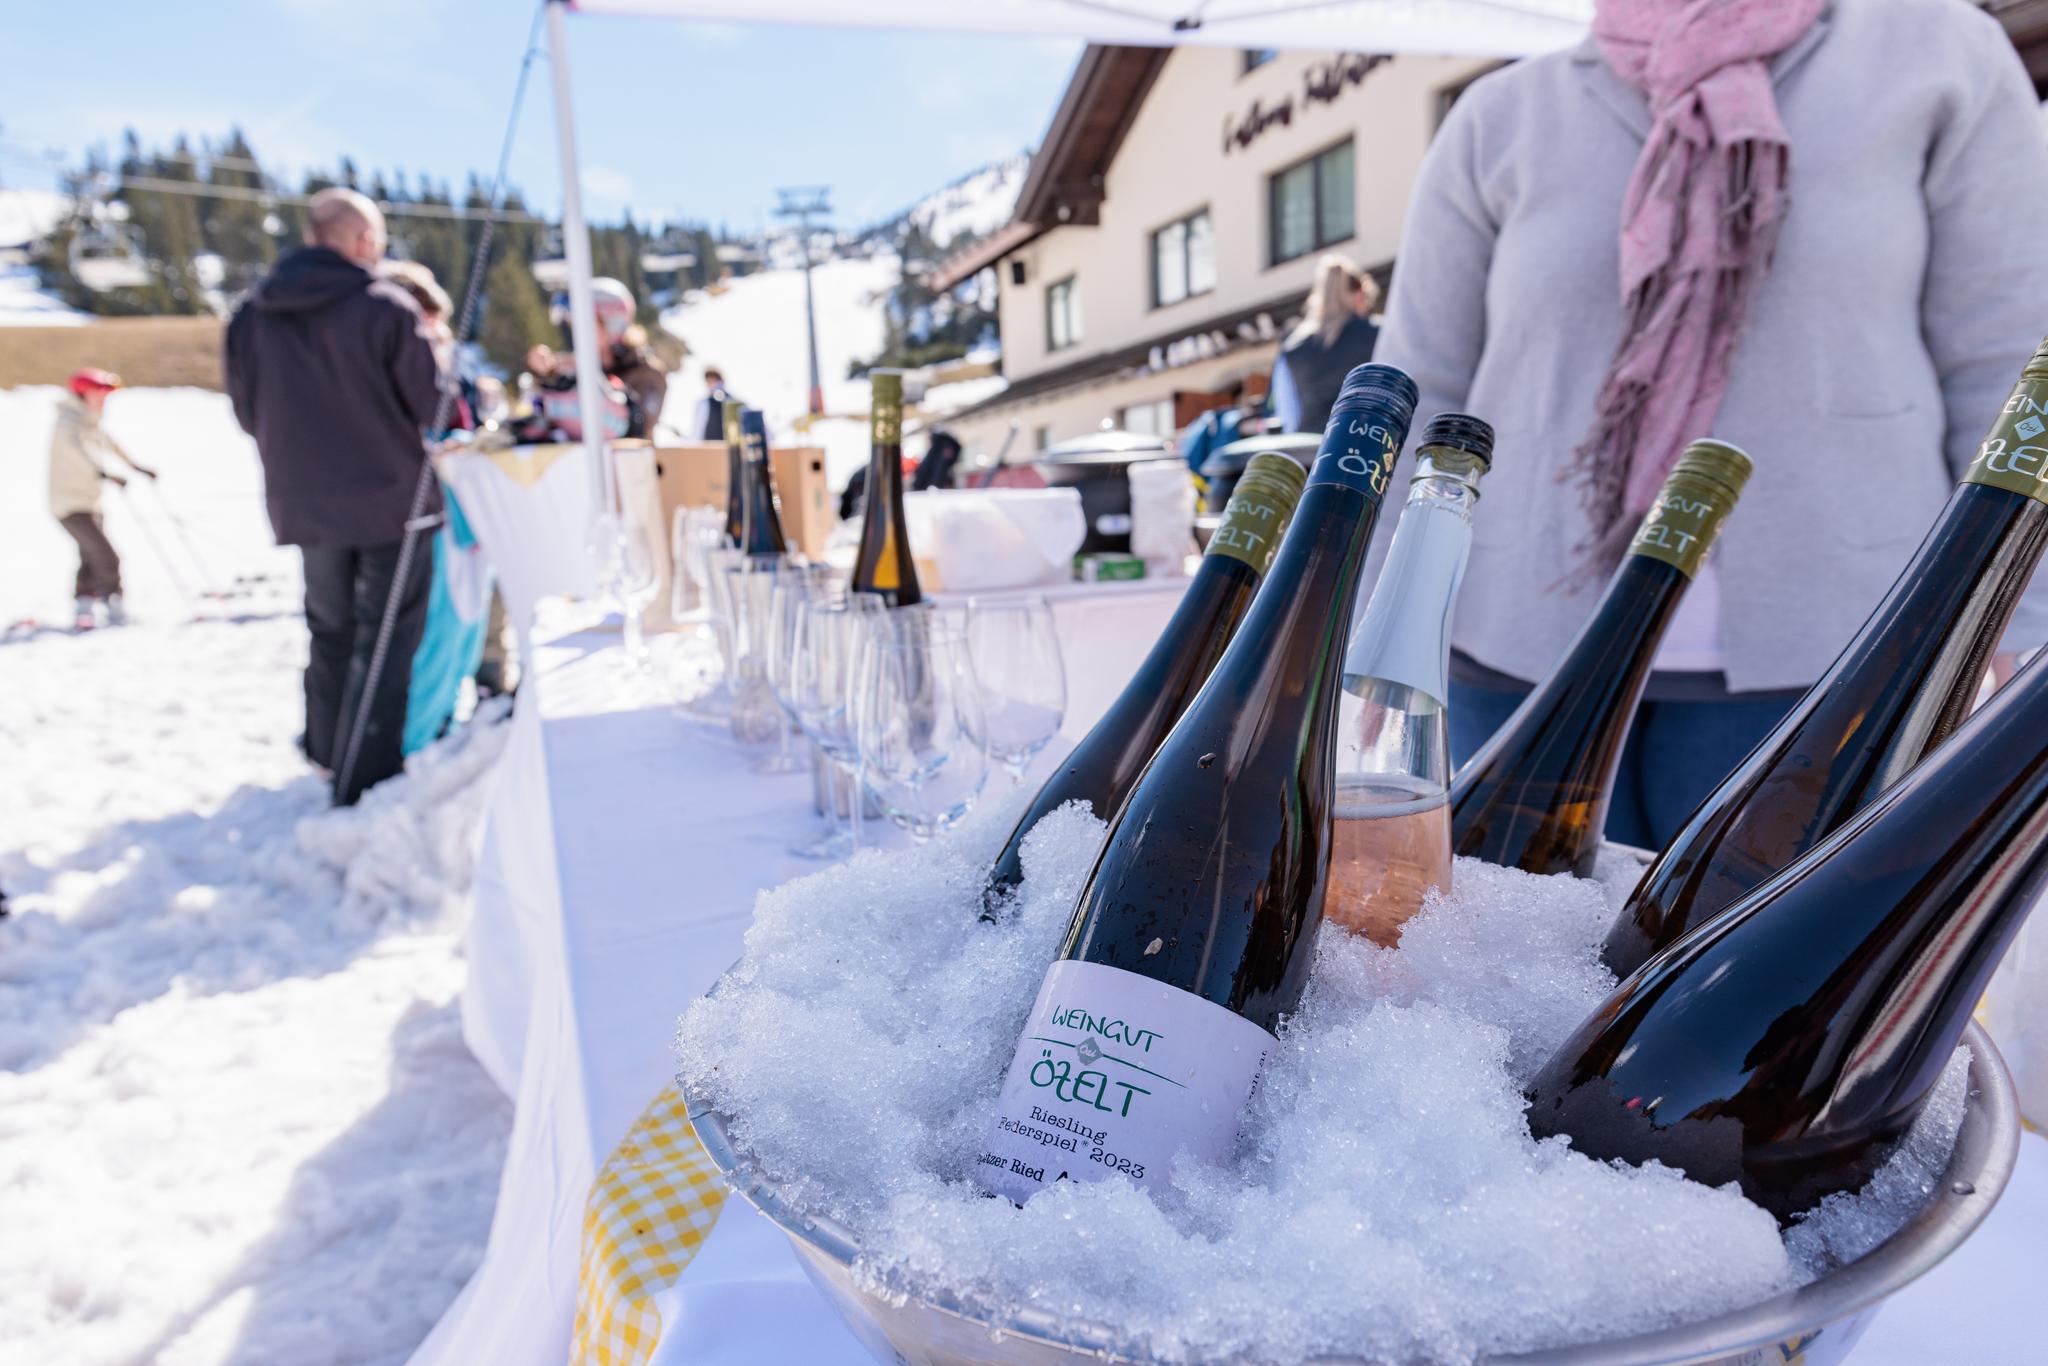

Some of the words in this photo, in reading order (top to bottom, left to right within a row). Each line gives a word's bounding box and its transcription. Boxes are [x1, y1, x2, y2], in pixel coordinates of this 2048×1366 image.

[1052, 1004, 1164, 1052] WEINGUT
[1030, 1049, 1152, 1118] ÖZELT
[1029, 1105, 1108, 1146] Riesling
[1009, 1158, 1045, 1182] Ried
[1089, 1147, 1147, 1179] 2023
